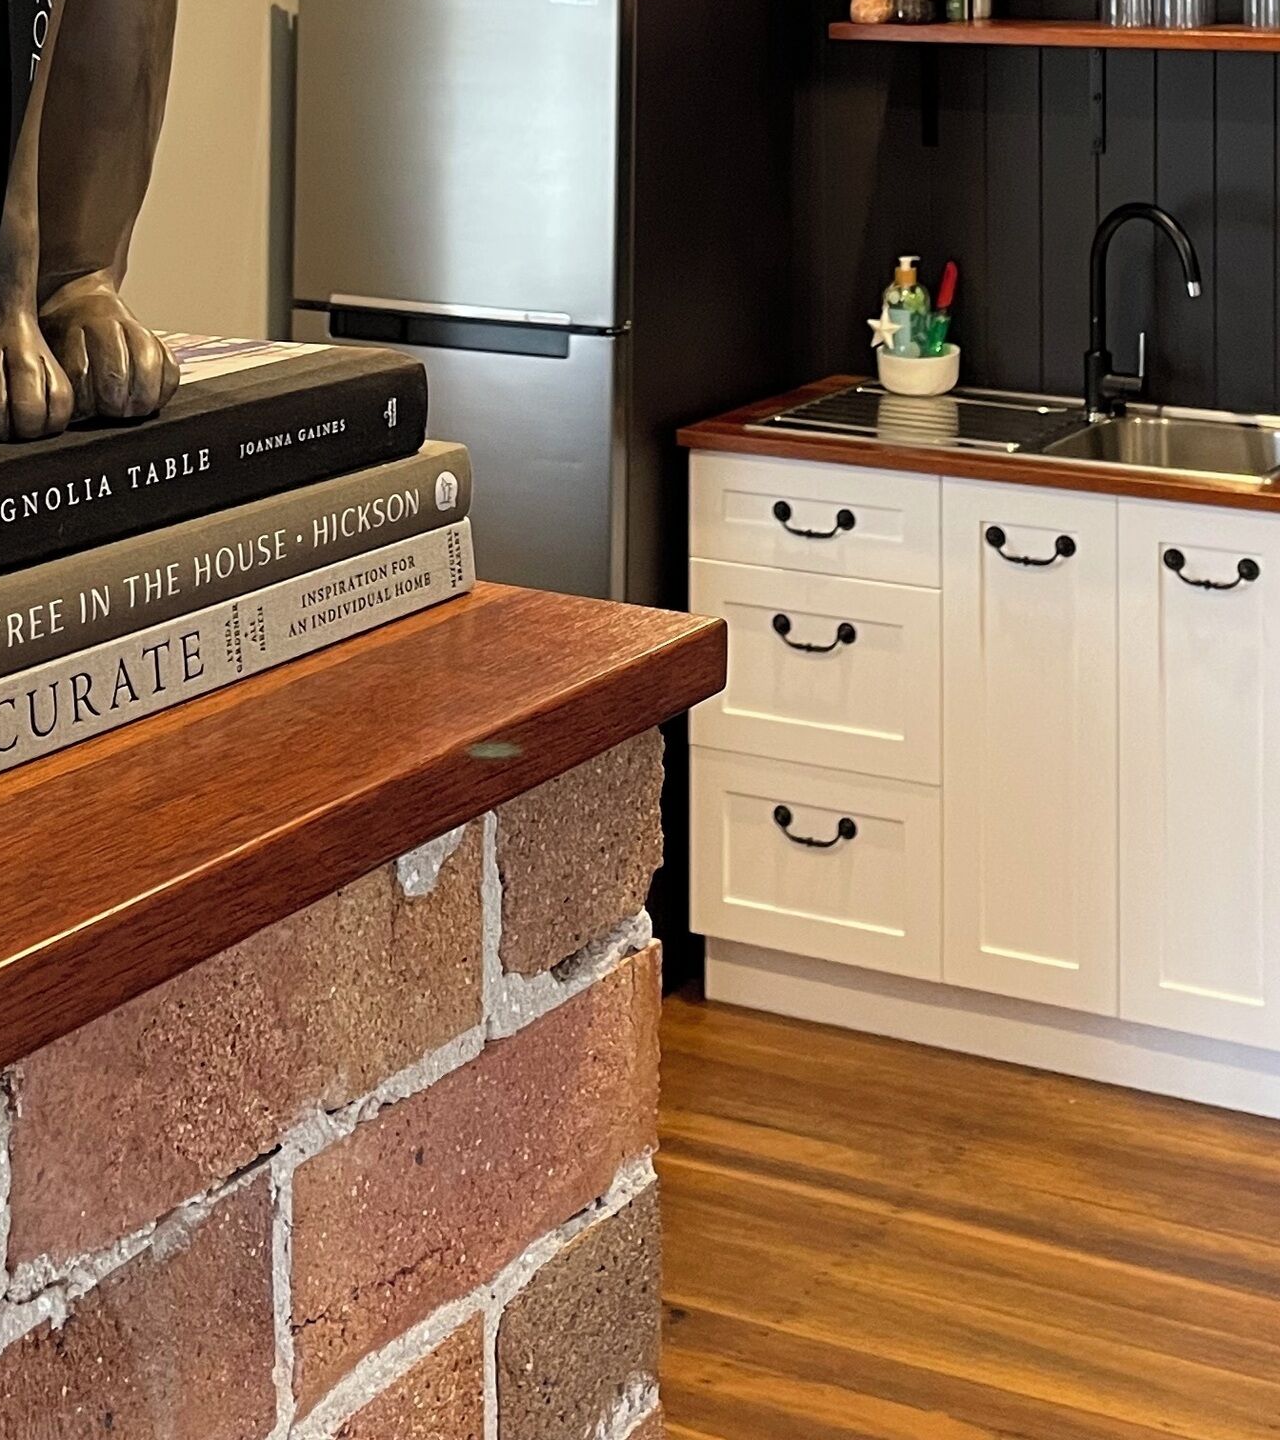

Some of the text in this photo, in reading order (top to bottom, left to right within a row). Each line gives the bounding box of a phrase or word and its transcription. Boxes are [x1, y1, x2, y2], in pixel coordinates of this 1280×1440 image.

[239, 418, 347, 459] JOANNA GAINES
[127, 447, 211, 489] TABLE
[79, 585, 111, 624] IN
[123, 562, 181, 608] THE
[194, 528, 287, 587] HOUSE
[312, 487, 420, 549] HICKSON
[301, 555, 417, 609] INSPIRATION FOR
[288, 572, 432, 638] AN INDIVIDUAL HOME
